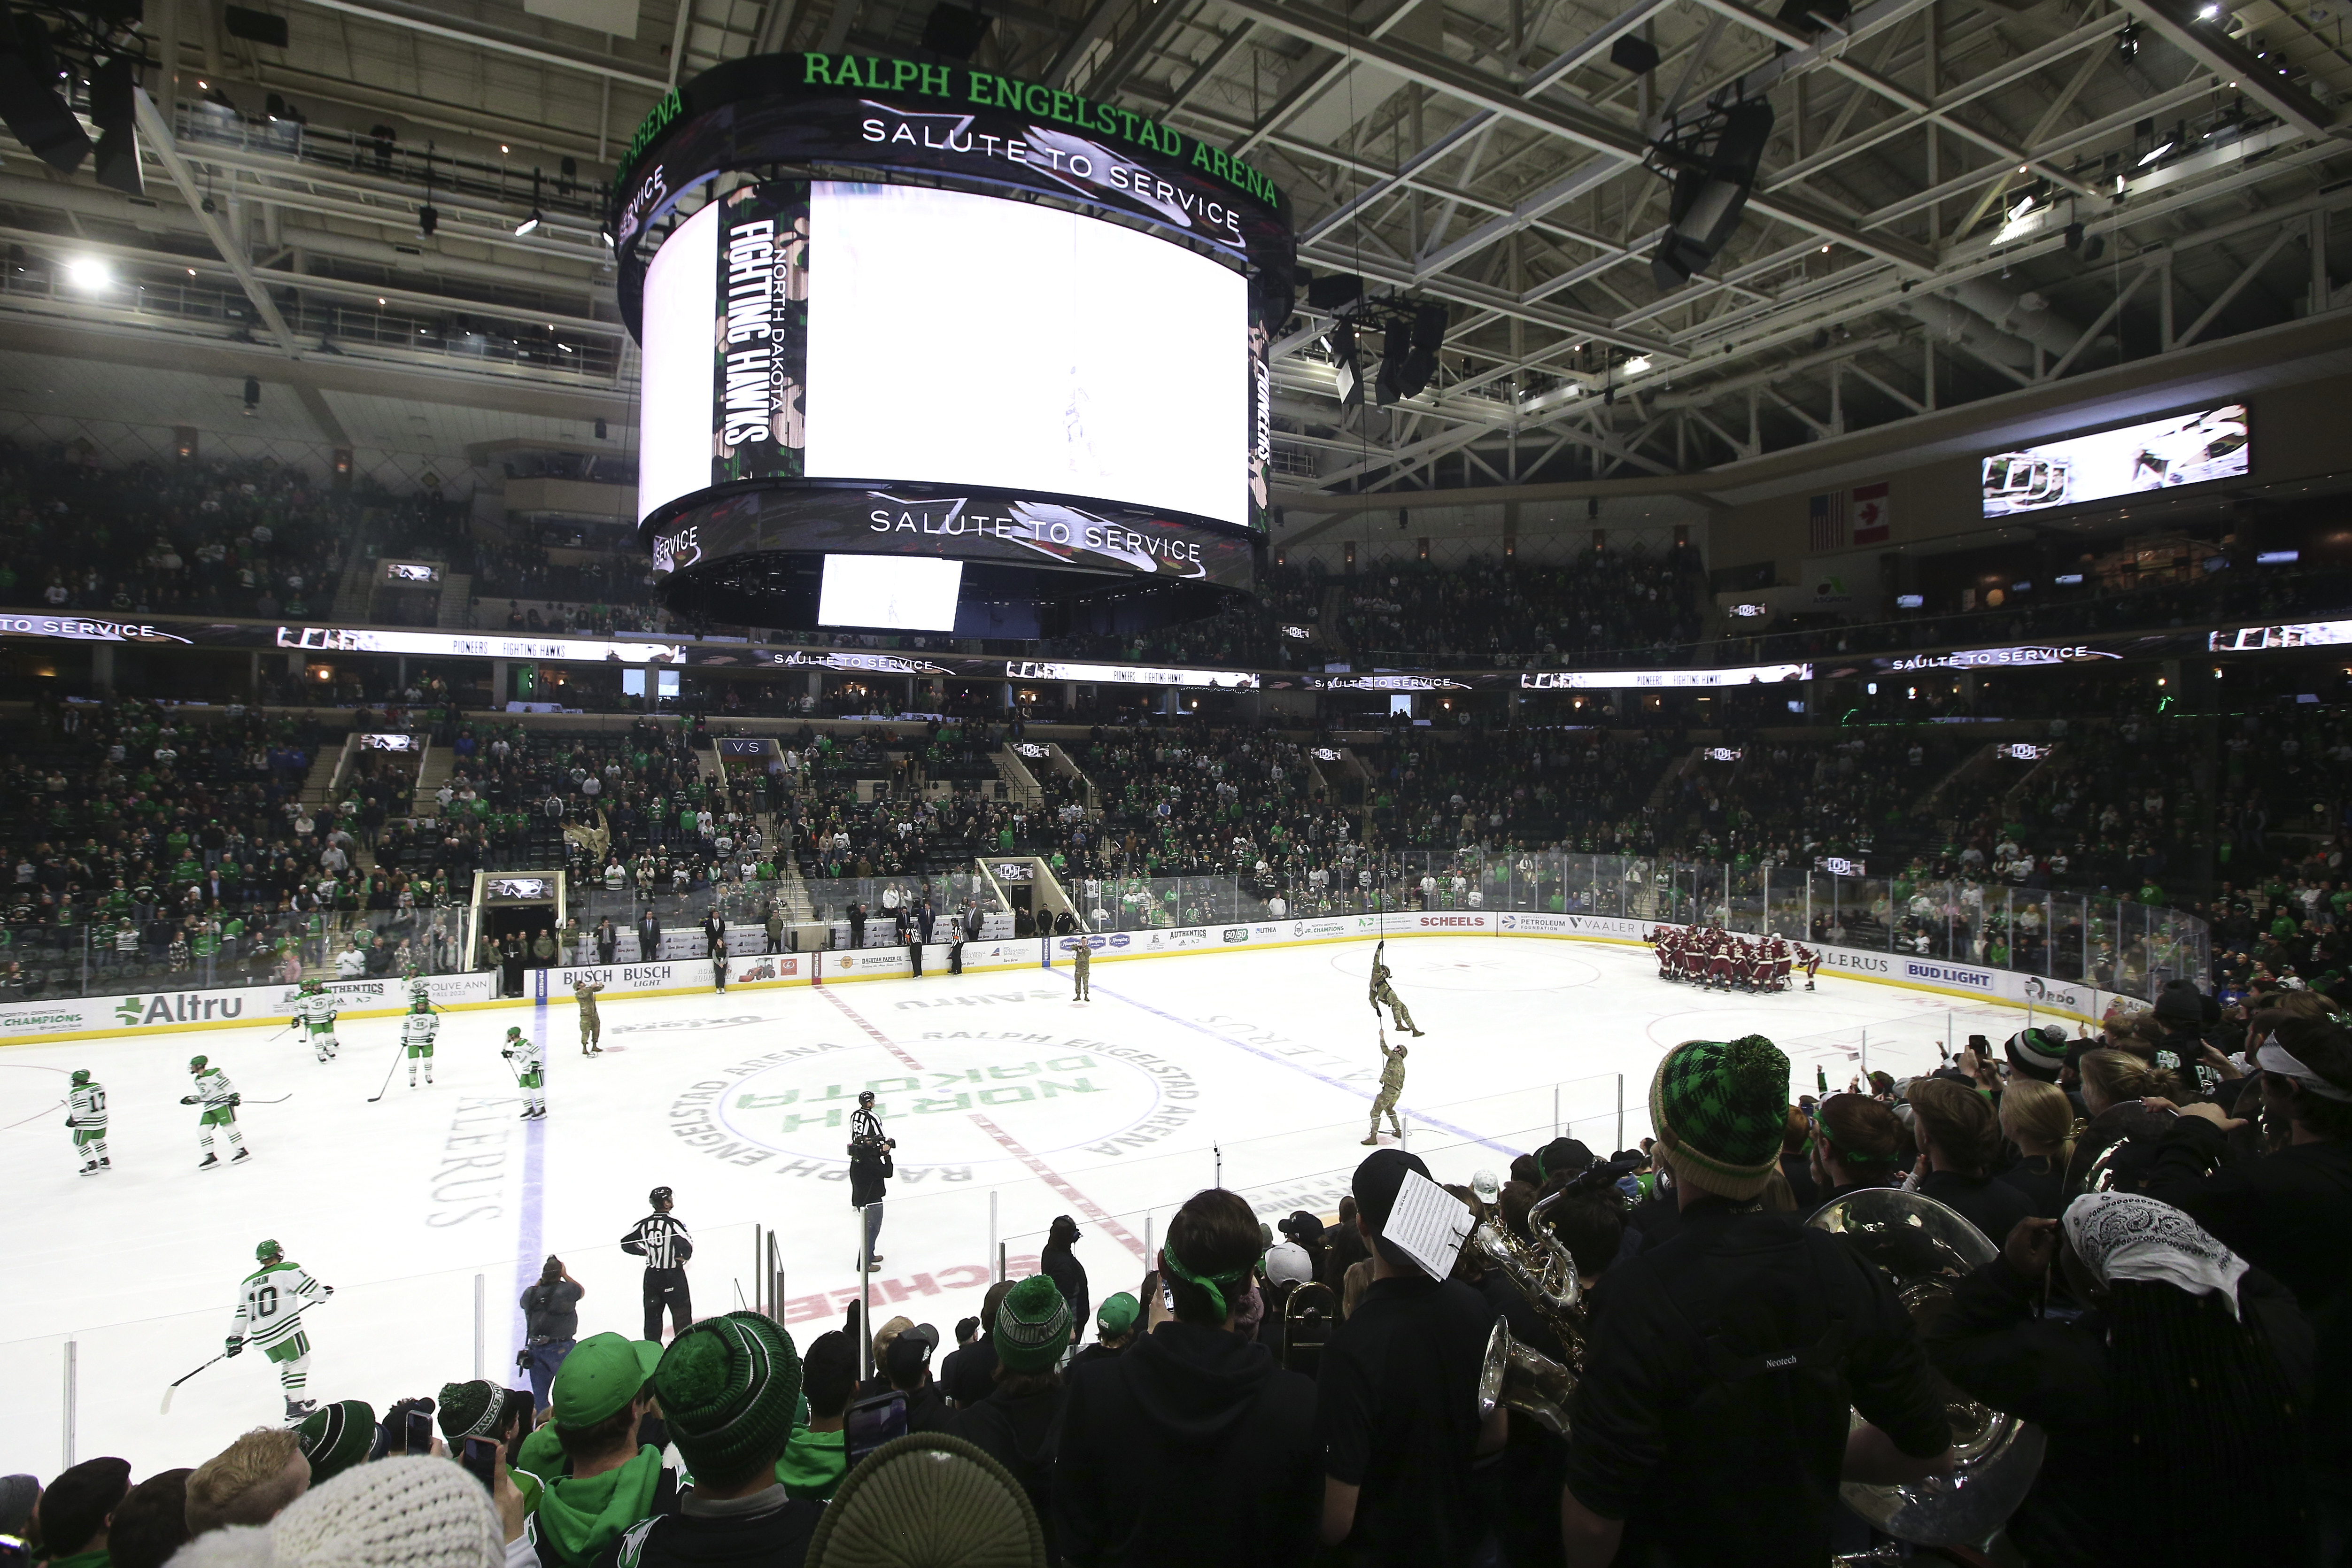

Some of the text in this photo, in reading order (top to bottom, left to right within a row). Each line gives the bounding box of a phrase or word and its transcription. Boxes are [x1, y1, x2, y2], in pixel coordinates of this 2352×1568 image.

[804, 52, 1277, 208] RALPH ENGELSTAD ARENA
[863, 119, 1240, 233] SALUTE TO SERVICE
[724, 219, 774, 446] FIGHTING HAWKS
[770, 249, 787, 411] NORTH DAKOTA
[870, 510, 1201, 564] SALUTE TO SERVICE
[655, 525, 698, 566] SERVICE
[0, 619, 155, 637] TO SERVICE
[453, 640, 488, 654] PIONEERS
[503, 642, 565, 658] FIGHTING HAWKS
[774, 654, 933, 670] SAULTE TO SERVICE
[1893, 646, 2088, 670] SAULTE TO SERVICE
[1114, 671, 1136, 682] PIONEERS
[1145, 672, 1184, 684] FIGHTING HAWKS
[1372, 679, 1388, 687] TO
[1393, 678, 1451, 687] SERVICE
[1637, 675, 1663, 686] PIONEERS
[1674, 673, 1722, 686] FIGHTING HAWKS
[733, 742, 759, 752] VS
[1420, 917, 1485, 926] SCHEELS
[1585, 920, 1634, 932] VAALER
[1170, 929, 1207, 940] AUTHENTICS
[1225, 930, 1246, 939] 50/50
[564, 969, 612, 985] BUSCH
[624, 966, 671, 981] BUSCH
[1909, 964, 1990, 986] BUD LIGHT
[432, 981, 461, 991] OLIVE
[464, 980, 487, 989] ANN
[2046, 991, 2075, 1005] RDO
[143, 994, 242, 1024] Altru
[4, 1013, 83, 1027] CHAMPIONS
[735, 1055, 1098, 1109] DAKOTA
[922, 1032, 1199, 1156] RALPH ENGELSTAD ARENA
[90, 1092, 105, 1113] 17
[670, 1043, 846, 1166] ENGELSTAD ARENA
[853, 1120, 864, 1134] 83
[775, 1159, 972, 1184] RAPH
[646, 1231, 664, 1247] 40
[248, 1284, 277, 1323] 10
[1766, 1355, 1796, 1368] Neotech
